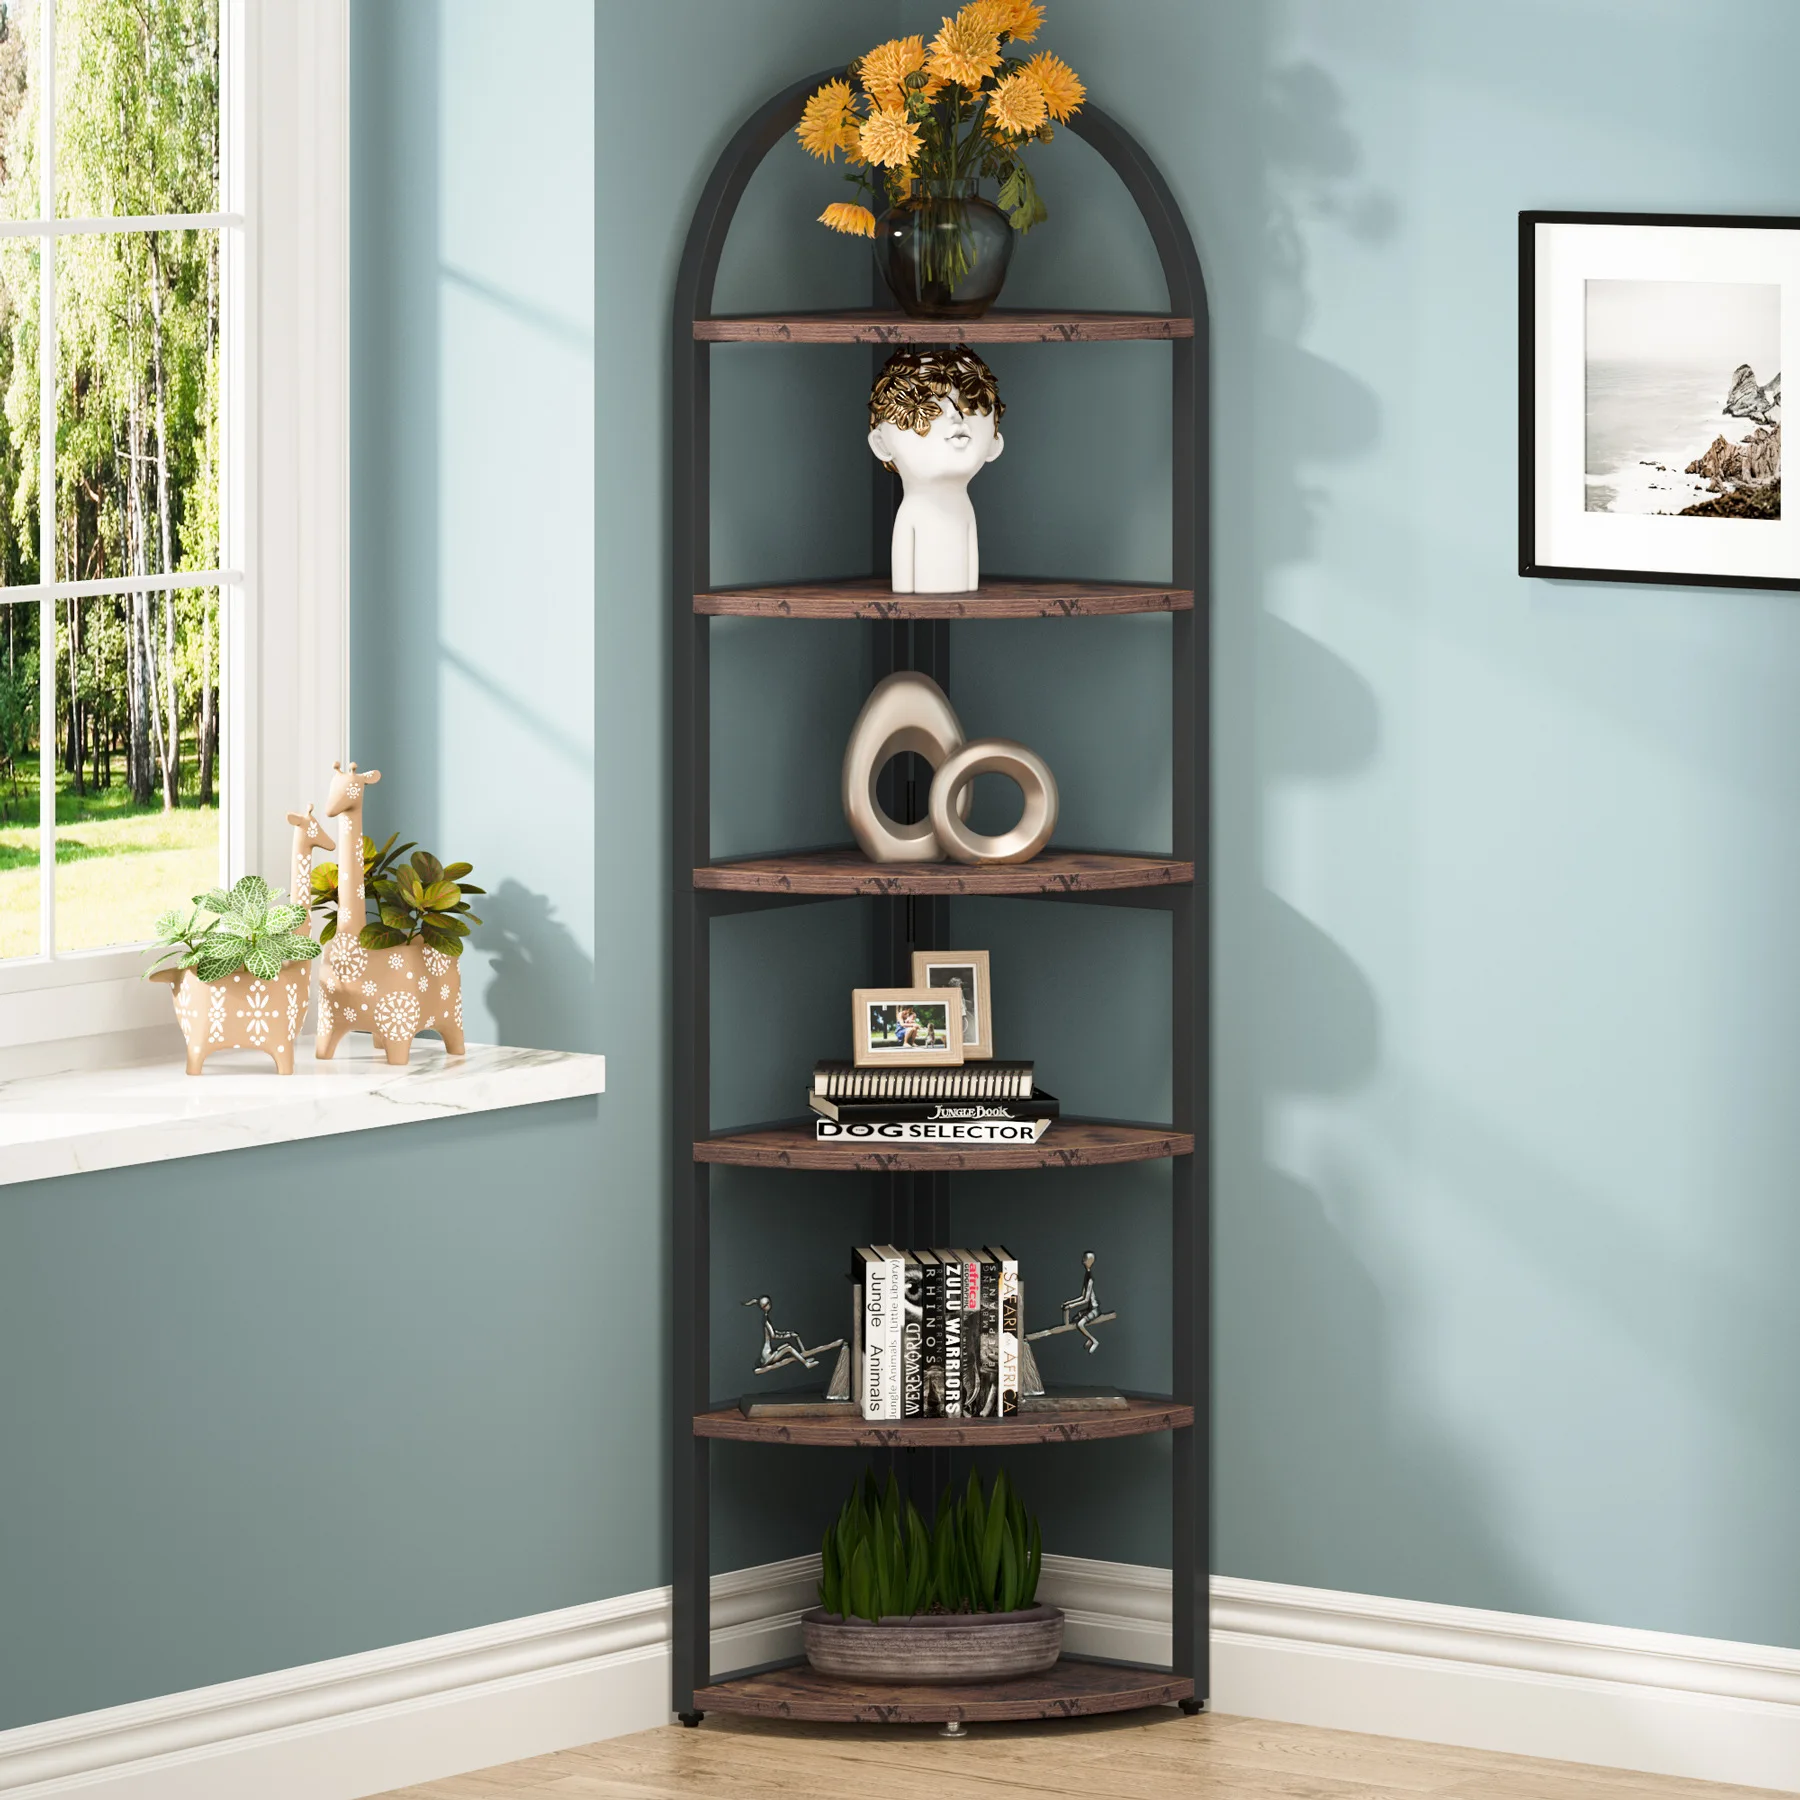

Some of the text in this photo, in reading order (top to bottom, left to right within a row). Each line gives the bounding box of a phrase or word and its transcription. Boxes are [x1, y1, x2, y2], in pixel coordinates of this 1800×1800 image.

[818, 1122, 1034, 1139] DOG SELECTOR
[889, 1259, 901, 1300] Library)
[968, 1262, 979, 1310] africa
[1003, 1271, 1019, 1332] SAFARI
[867, 1272, 886, 1412] Jungle Animals
[926, 1268, 936, 1364] RHINOS
[945, 1264, 962, 1414] ZULU WARRIORS
[888, 1339, 898, 1382] Animals
[904, 1322, 923, 1416] WEREWORLD
[1003, 1350, 1017, 1413] AFRICA
[888, 1385, 900, 1418] Jungle
